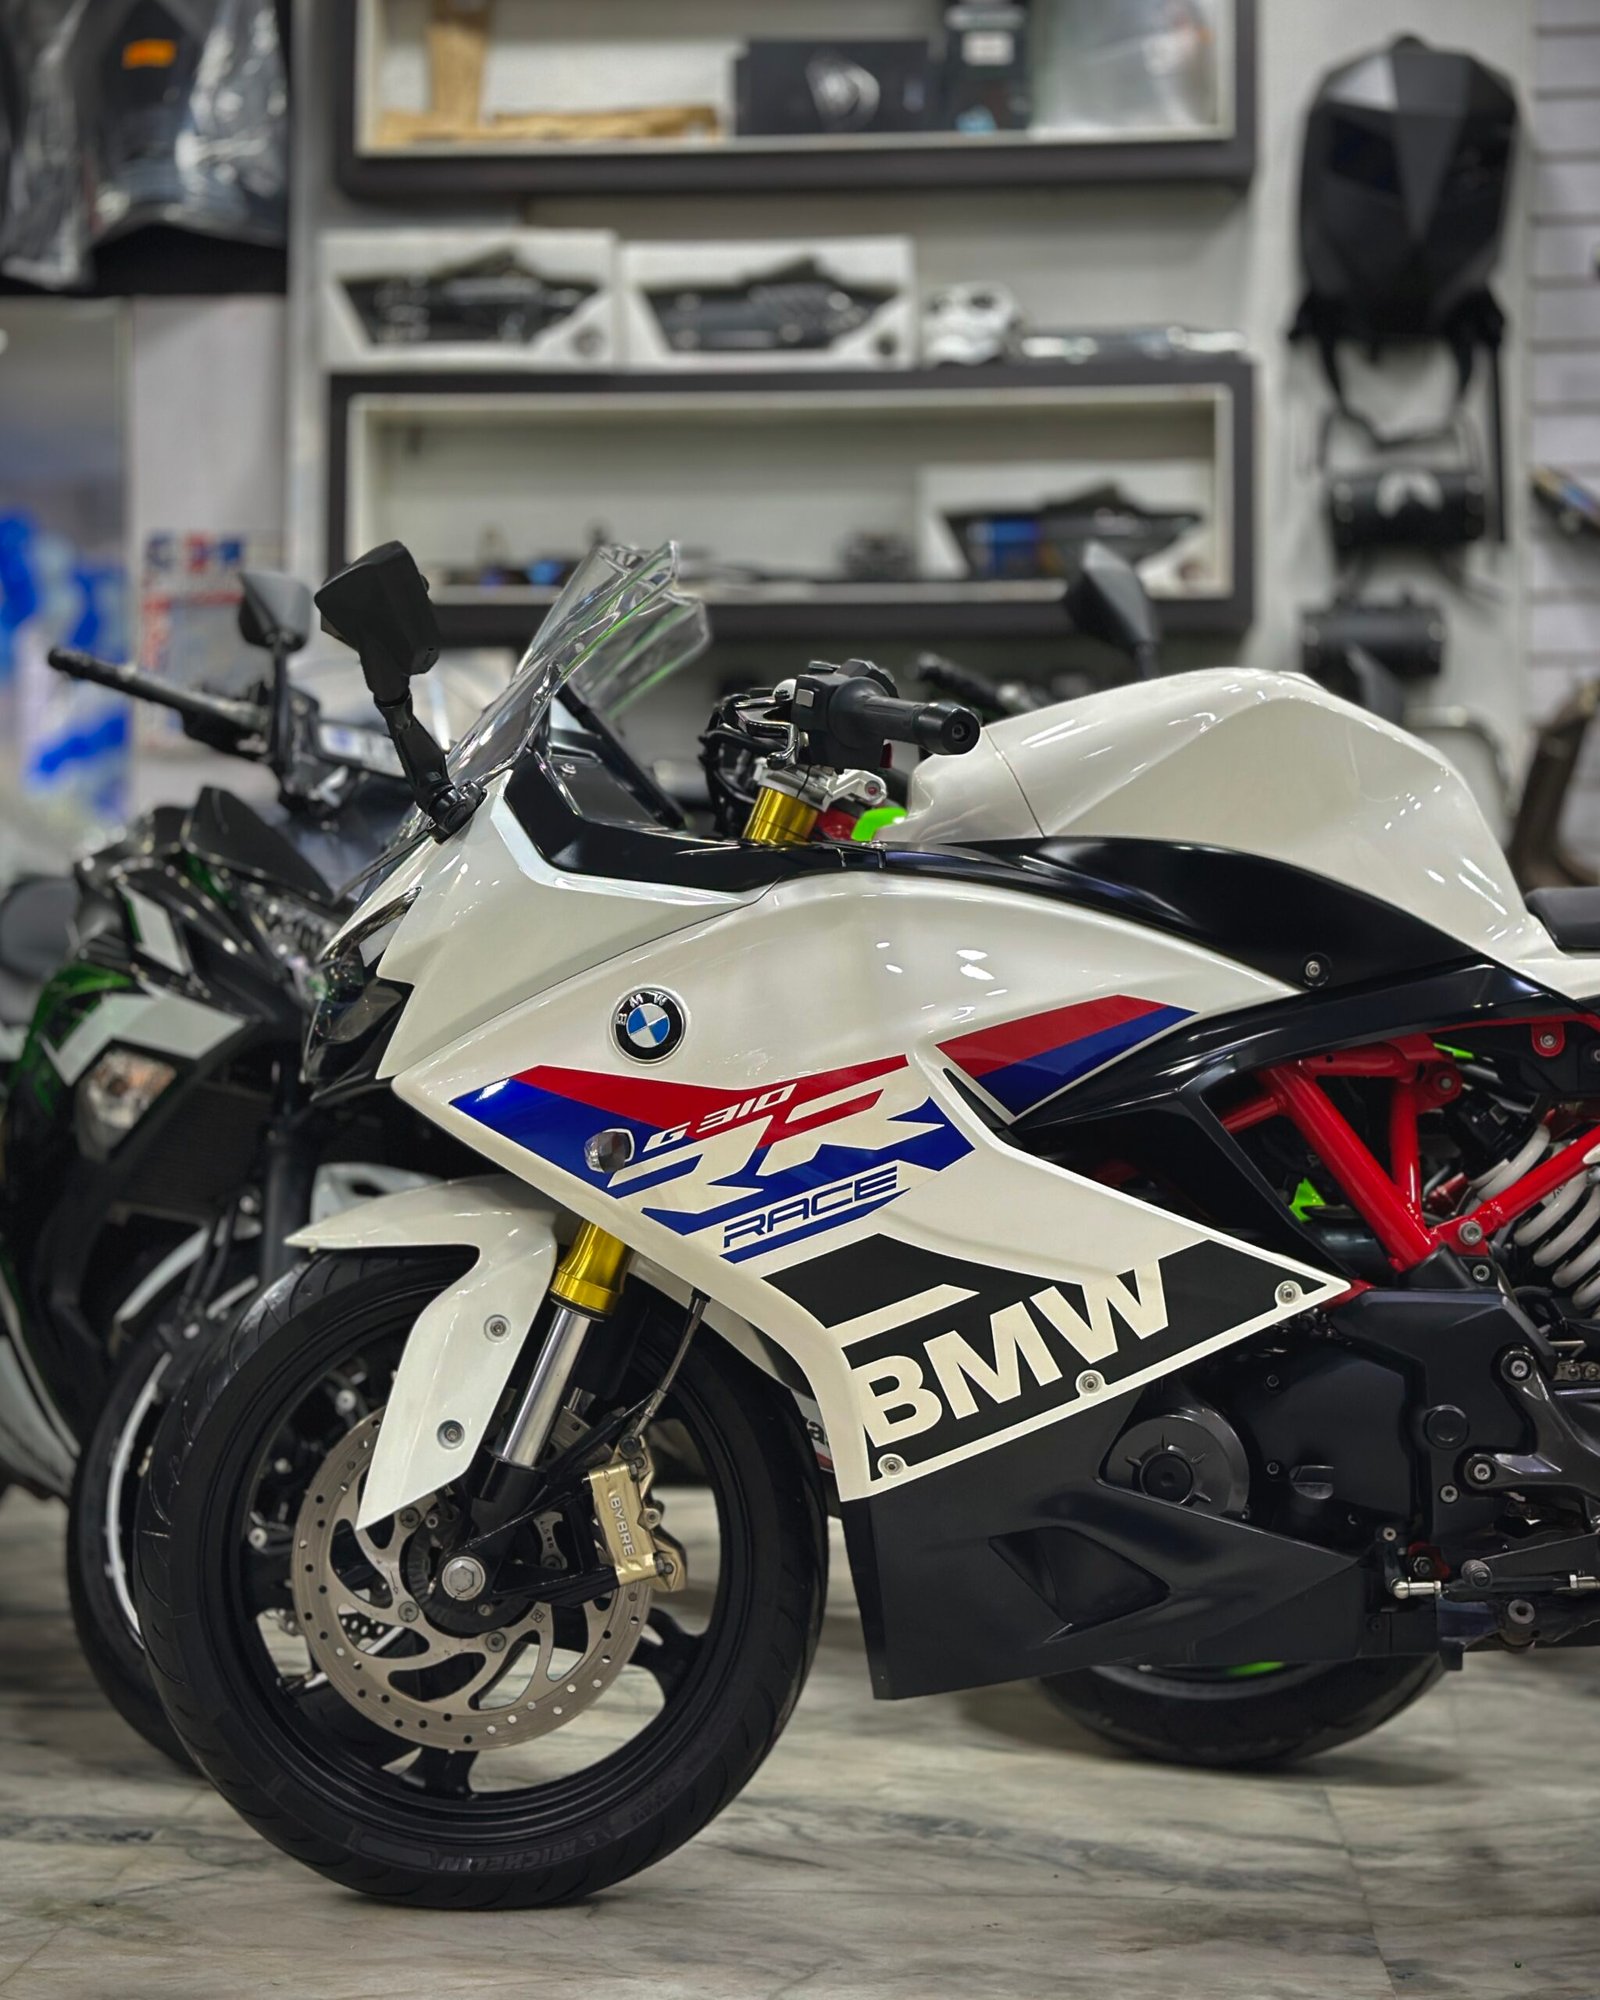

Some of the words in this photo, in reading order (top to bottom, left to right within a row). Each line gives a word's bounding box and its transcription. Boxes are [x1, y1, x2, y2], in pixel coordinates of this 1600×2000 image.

[615, 992, 668, 1027] BMW
[642, 1122, 691, 1153] G
[696, 1083, 798, 1134] 310
[723, 1166, 898, 1249] RACE
[856, 1259, 1169, 1448] BMW
[609, 1496, 636, 1557] BYBRE
[438, 1838, 577, 1873] MICHELIN
